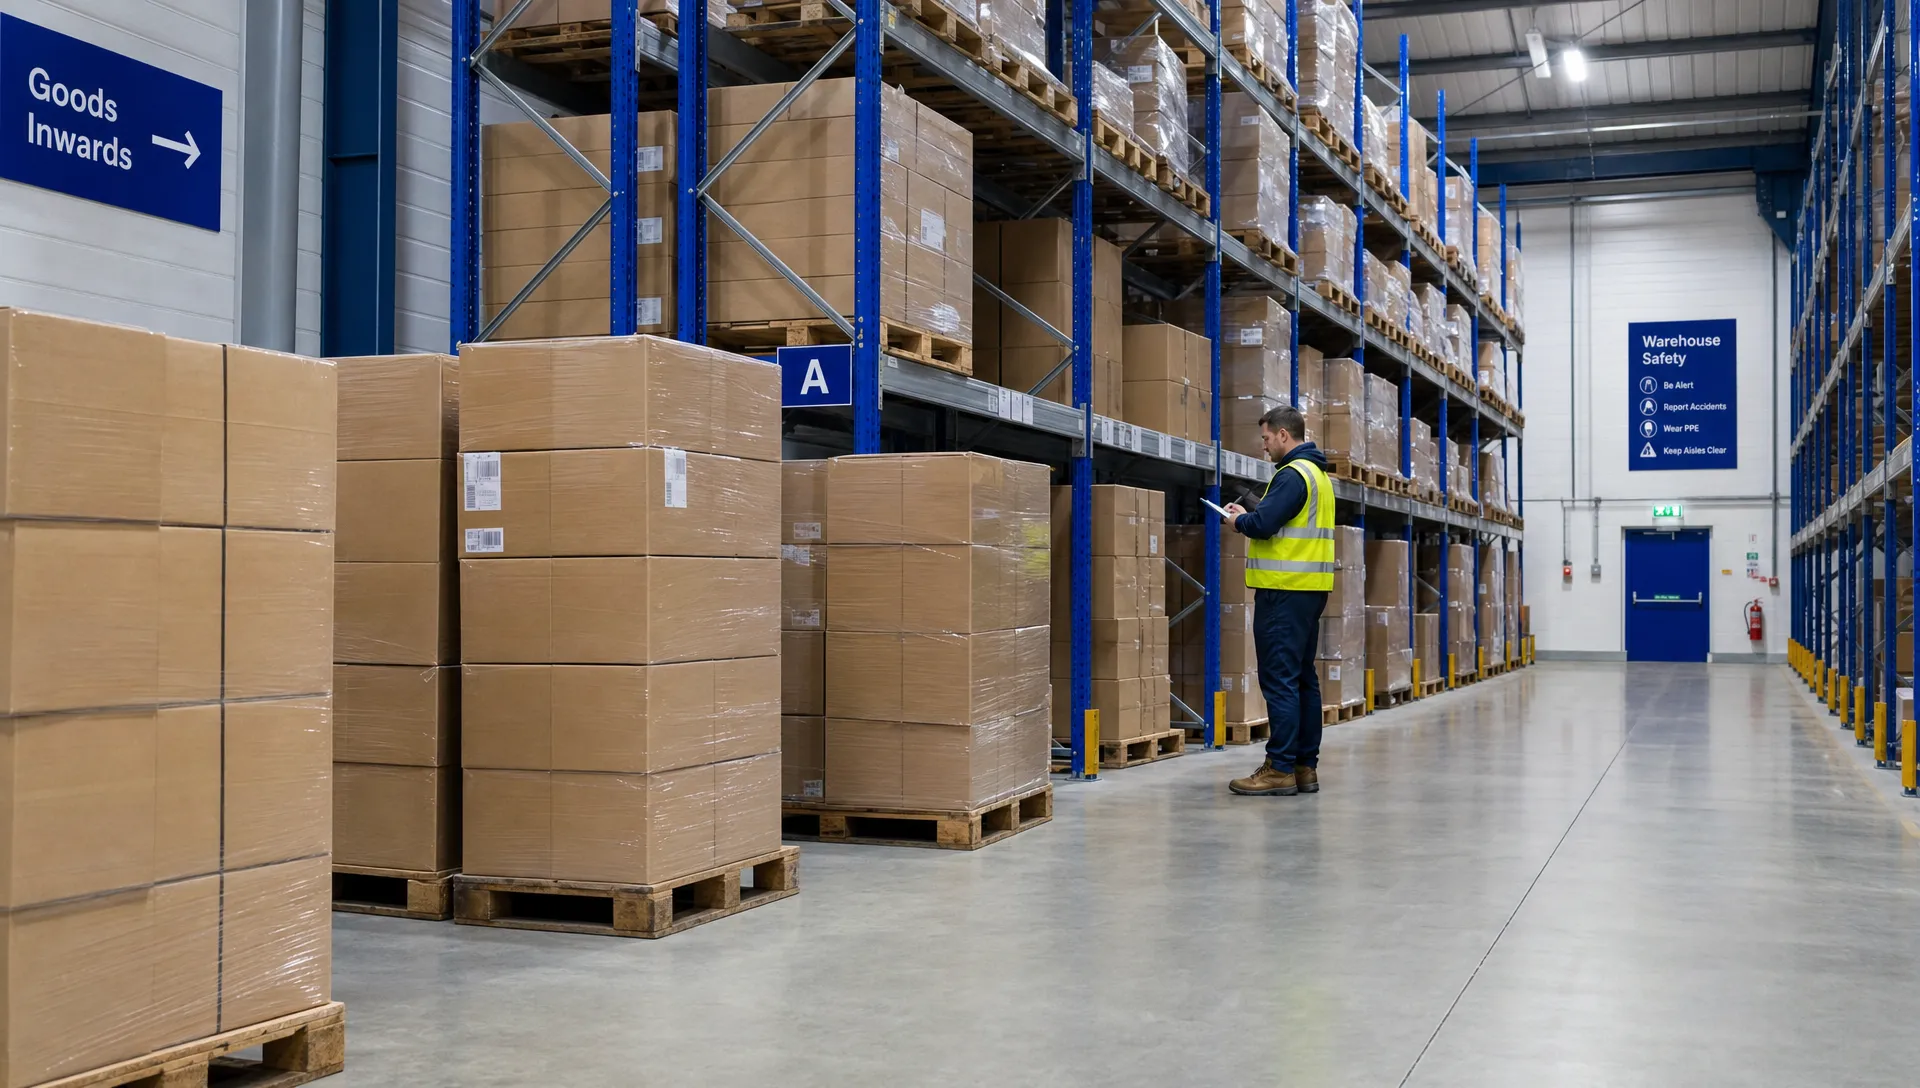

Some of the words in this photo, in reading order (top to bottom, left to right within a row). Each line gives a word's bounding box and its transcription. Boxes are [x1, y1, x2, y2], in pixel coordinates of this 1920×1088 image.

[28, 67, 118, 122] Goods
[28, 112, 132, 170] Inwards
[1642, 334, 1720, 348] Warehouse
[1642, 352, 1686, 367] Safety
[800, 358, 830, 394] A
[1664, 382, 1674, 390] Be
[1675, 382, 1694, 390] Alert
[1664, 404, 1689, 412] Report
[1690, 402, 1726, 410] Accidents
[1664, 424, 1682, 432] Wear
[1664, 446, 1682, 455] Keep
[1684, 446, 1706, 454] Aisles
[1706, 446, 1726, 454] Clear
